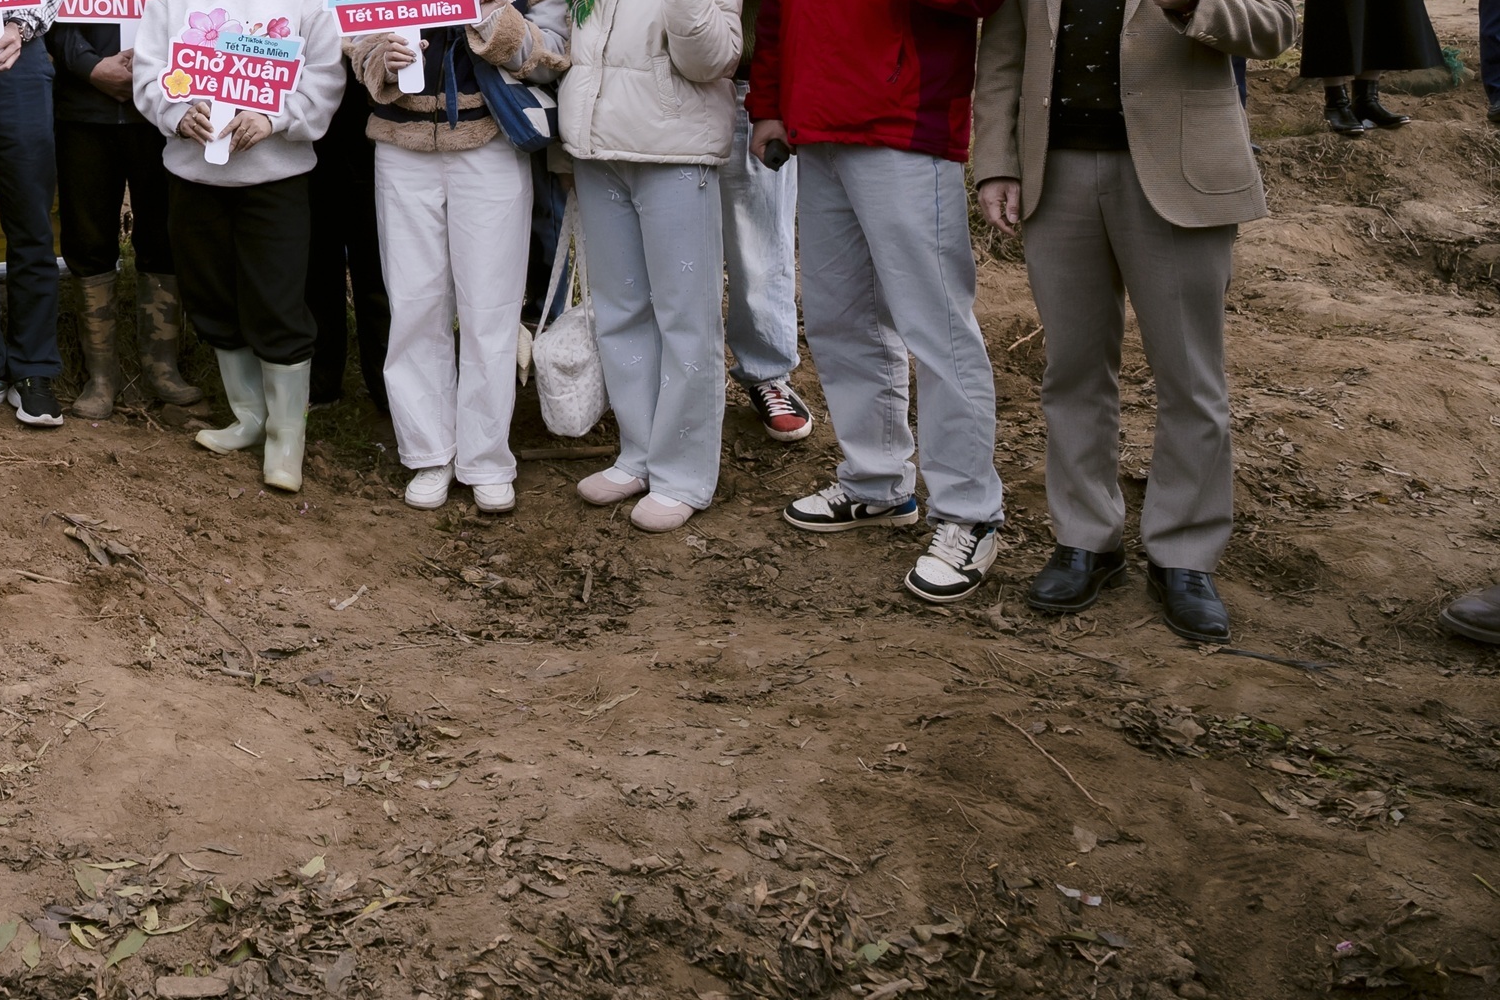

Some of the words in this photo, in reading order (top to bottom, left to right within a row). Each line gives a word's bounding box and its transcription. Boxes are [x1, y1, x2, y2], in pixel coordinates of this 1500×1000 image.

[346, 7, 372, 23] Tết
[375, 7, 394, 21] Ta
[397, 5, 418, 20] Ba
[421, 1, 462, 17] Miền
[225, 41, 240, 51] Tết
[241, 43, 251, 53] Ta
[253, 45, 265, 55] Ba
[266, 46, 289, 58] Miền
[245, 36, 263, 45] TikTok
[264, 39, 278, 47] Shop
[177, 48, 226, 71] Chở
[229, 55, 289, 82] Xuân
[194, 74, 218, 92] Về
[221, 76, 274, 105] Nhà
